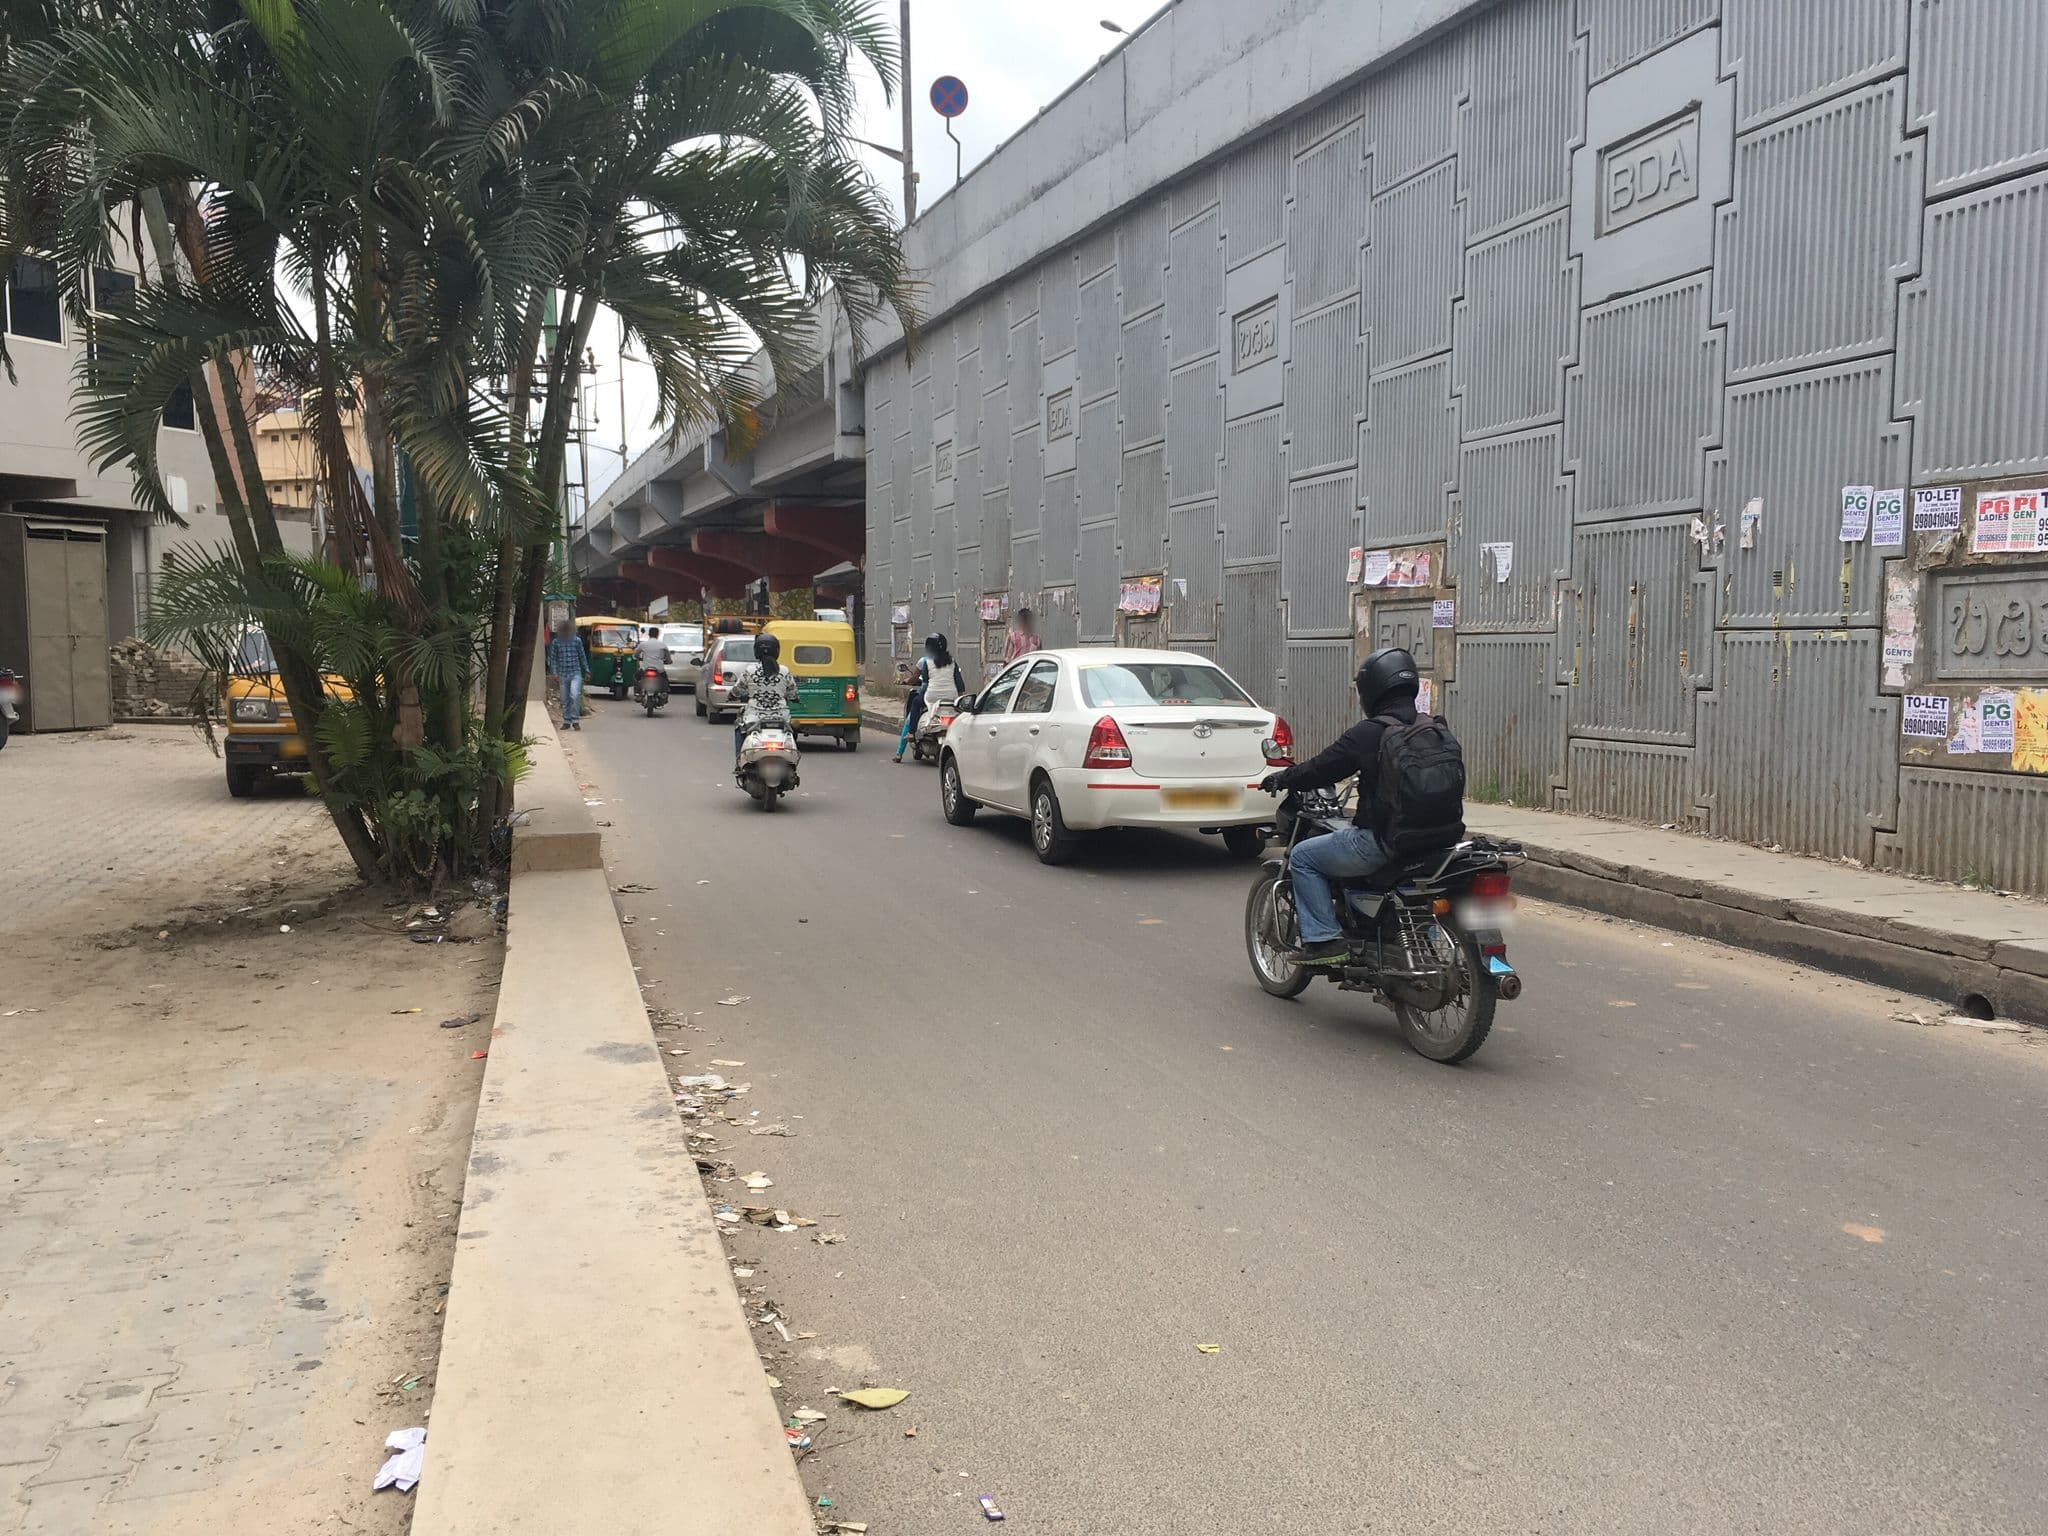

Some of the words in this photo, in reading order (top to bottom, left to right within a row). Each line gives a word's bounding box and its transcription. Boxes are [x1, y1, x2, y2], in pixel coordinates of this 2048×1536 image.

[1610, 138, 1690, 214] BDA
[1050, 401, 1072, 433] BDA
[1844, 495, 1868, 511] PG
[1917, 488, 1960, 502] TO-LET
[1876, 499, 1901, 516] PG
[1979, 498, 2010, 515] PG
[1877, 514, 1899, 522] GENTS
[1914, 511, 1958, 529] 9980410945
[1978, 513, 2009, 522] LADIES
[1885, 647, 1913, 658] GENTS
[1906, 696, 1947, 710] TO-LET
[1983, 704, 2011, 721] PG
[1904, 718, 1947, 737] 9980410945
